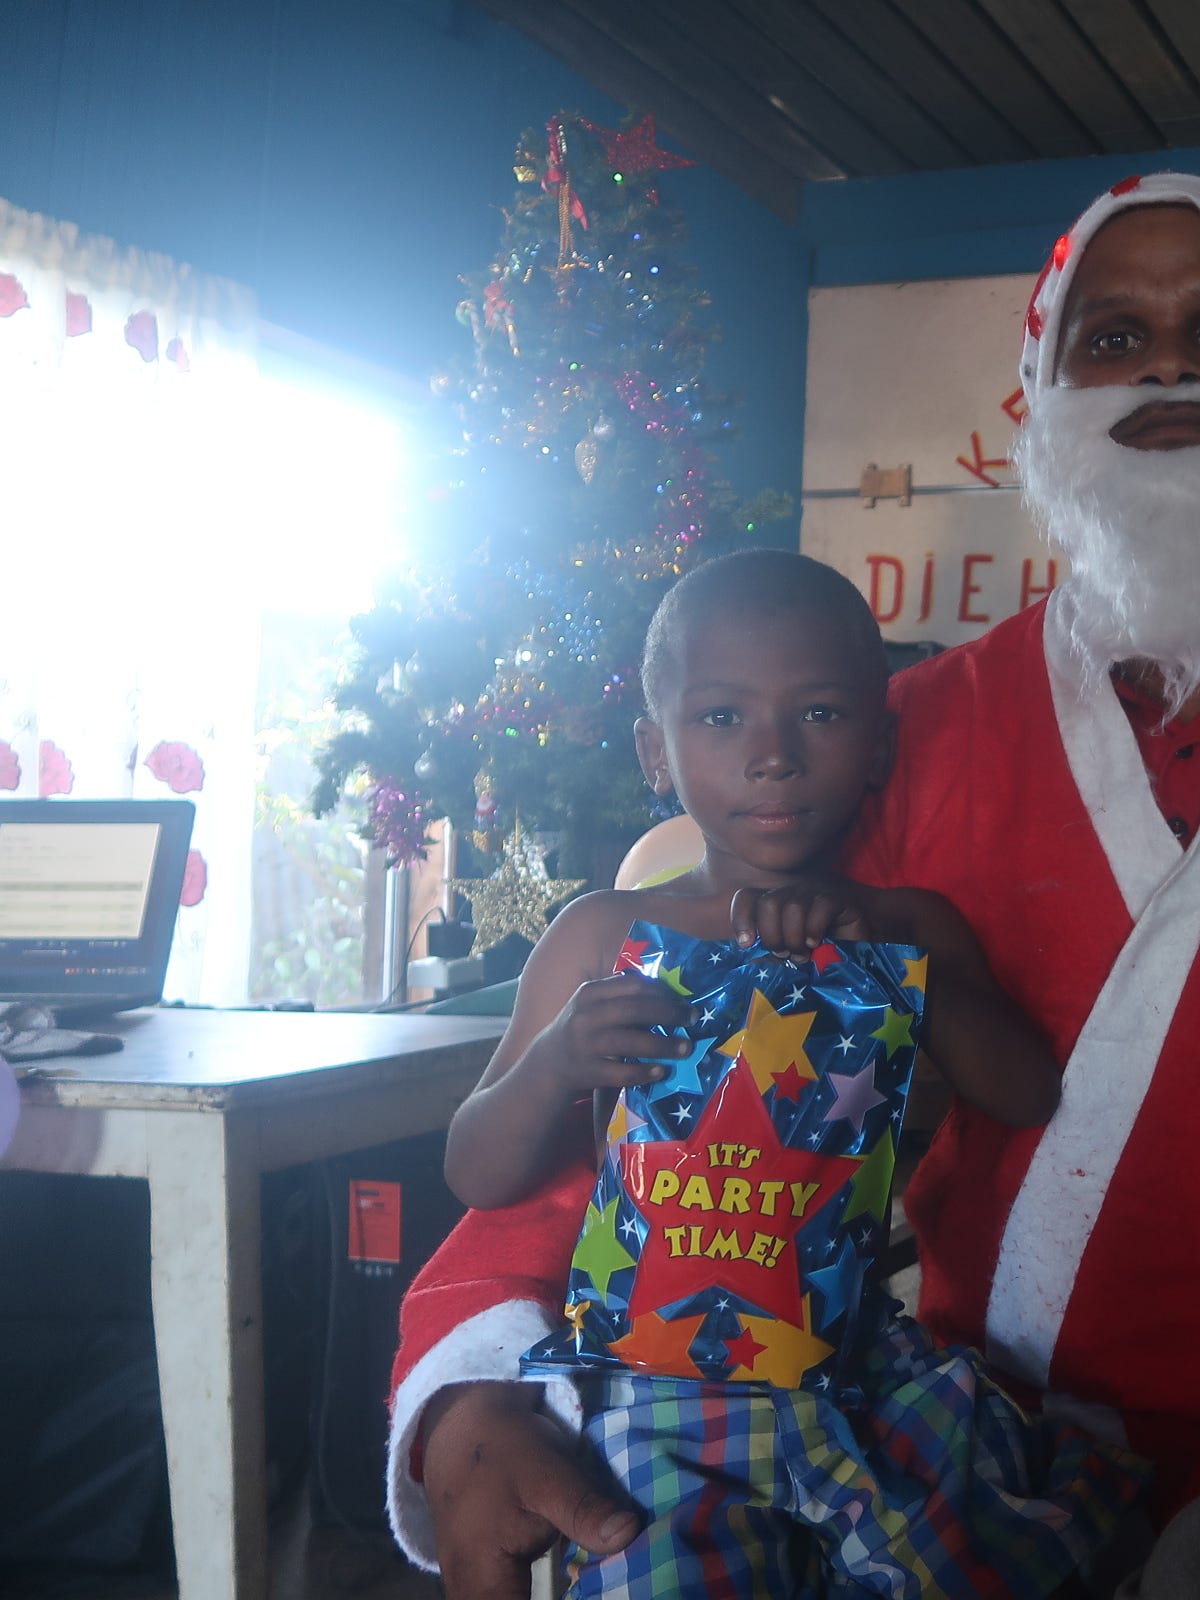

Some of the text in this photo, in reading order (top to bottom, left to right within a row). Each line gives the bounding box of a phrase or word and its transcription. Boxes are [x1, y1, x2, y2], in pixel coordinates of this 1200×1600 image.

[706, 1143, 760, 1169] IT'S
[649, 1169, 820, 1217] PARTY
[664, 1225, 788, 1269] TIME!
